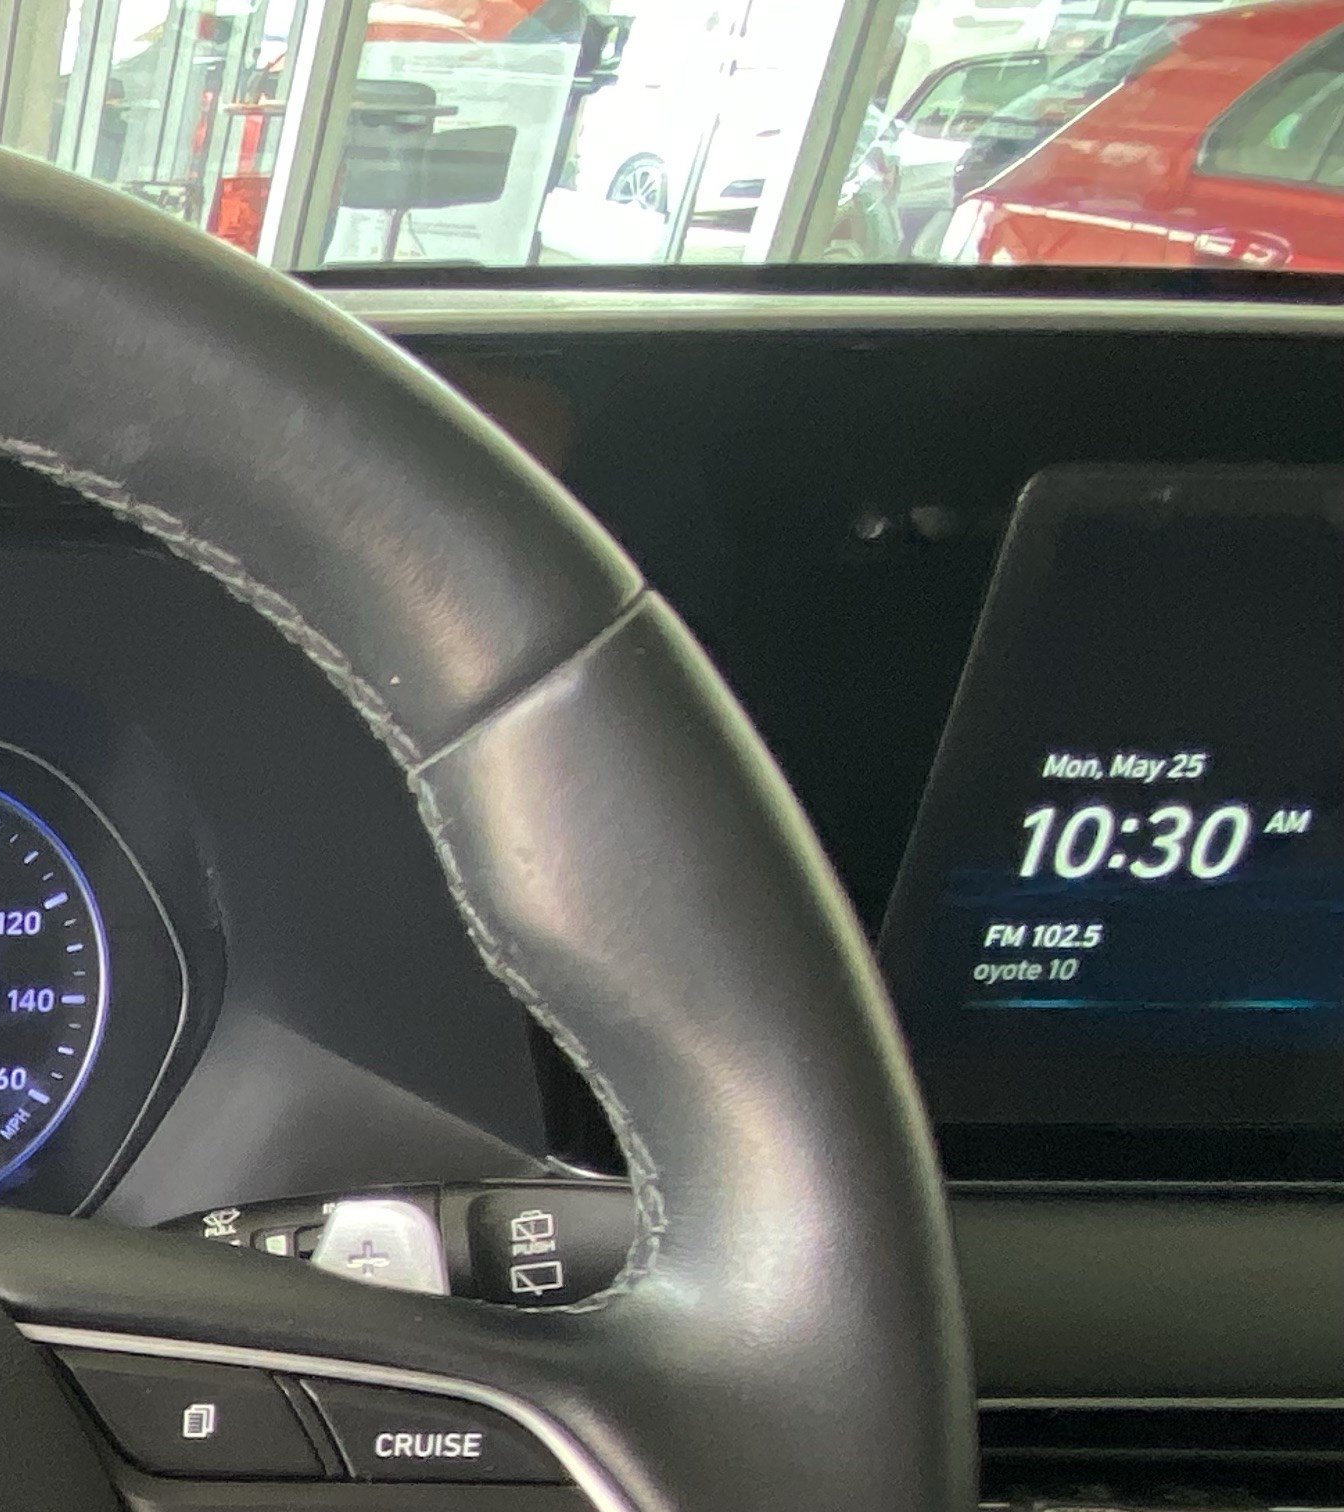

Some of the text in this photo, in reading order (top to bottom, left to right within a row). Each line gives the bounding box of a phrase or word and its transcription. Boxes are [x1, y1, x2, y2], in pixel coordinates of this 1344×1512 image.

[1043, 753, 1206, 783] Mon, May 25
[1264, 810, 1311, 834] AM
[1019, 804, 1251, 880] 10:30
[984, 924, 1103, 948] FM 102.5
[973, 958, 1078, 985] oyote 10
[8, 989, 54, 1013] 140
[375, 1433, 482, 1458] CRUISE
